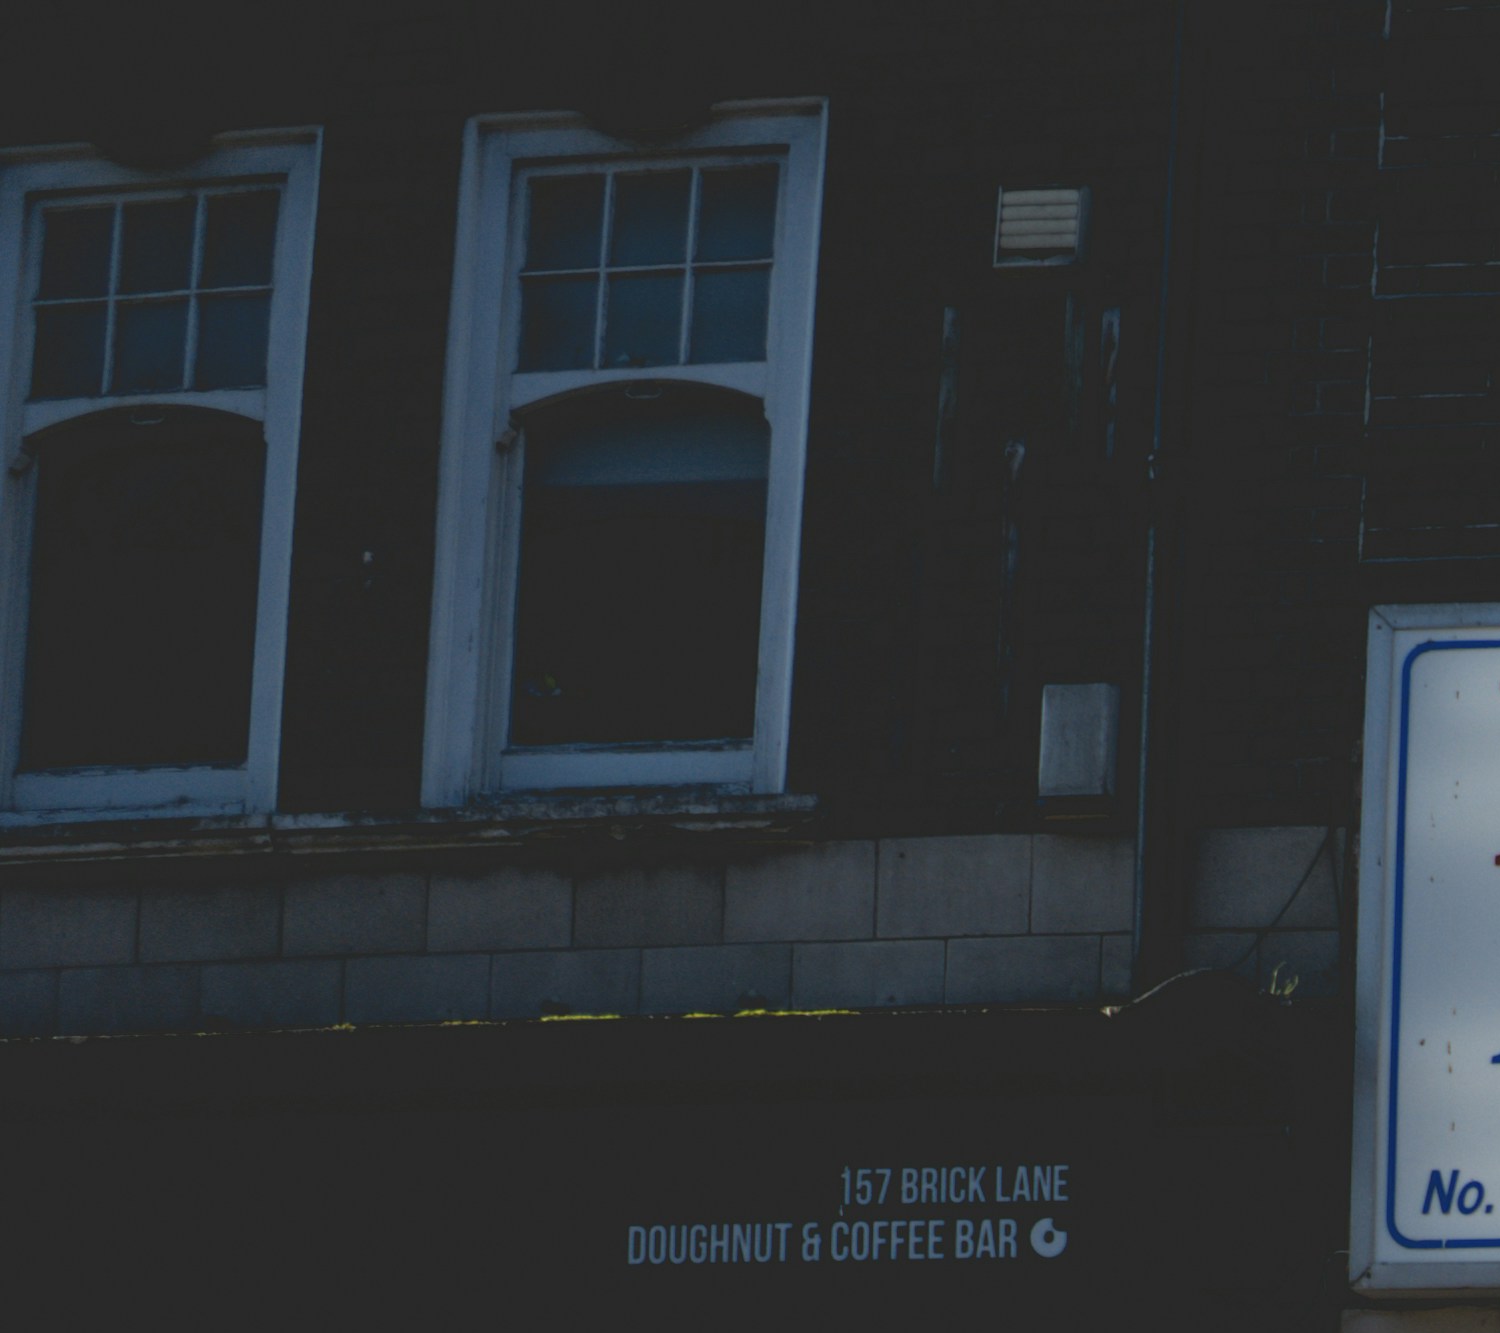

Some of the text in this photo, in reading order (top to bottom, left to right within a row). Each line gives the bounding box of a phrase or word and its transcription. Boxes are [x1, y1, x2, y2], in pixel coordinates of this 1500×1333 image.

[841, 1164, 1070, 1206] 157 BRICK LANE
[627, 1218, 1018, 1265] DOUGHNUT & COFFEE BAR
